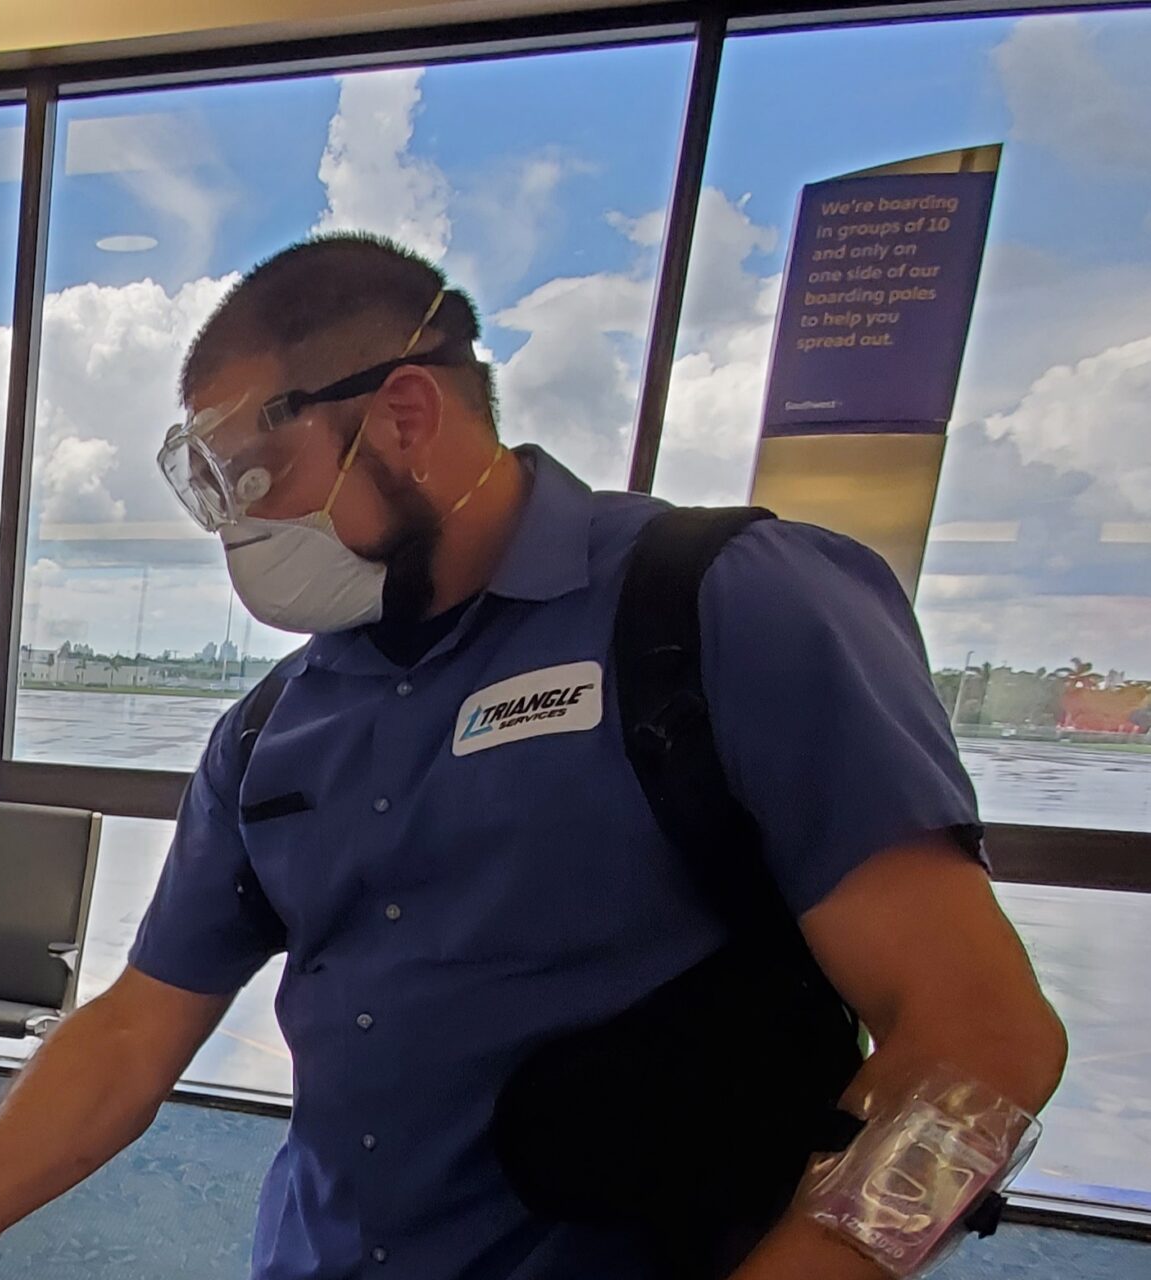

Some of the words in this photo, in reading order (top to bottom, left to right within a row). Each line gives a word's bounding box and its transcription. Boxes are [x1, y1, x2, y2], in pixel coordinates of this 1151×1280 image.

[822, 199, 874, 216] We're
[878, 195, 959, 213] boarding
[816, 225, 833, 239] in
[837, 222, 901, 241] groups
[904, 217, 926, 233] of
[927, 217, 950, 232] 10
[812, 244, 846, 261] and
[850, 243, 889, 260] only
[893, 244, 917, 256] on
[808, 271, 842, 283] one
[847, 265, 882, 280] side
[887, 263, 907, 278] of
[909, 265, 940, 278] our
[804, 288, 885, 306] boarding
[888, 286, 937, 304] poles
[800, 314, 818, 328] to
[823, 310, 861, 328] help
[866, 312, 900, 327] you
[797, 333, 856, 352] spread
[860, 333, 893, 346] out.
[480, 685, 588, 727] TRIANGLE
[498, 708, 567, 730] SERVICES
